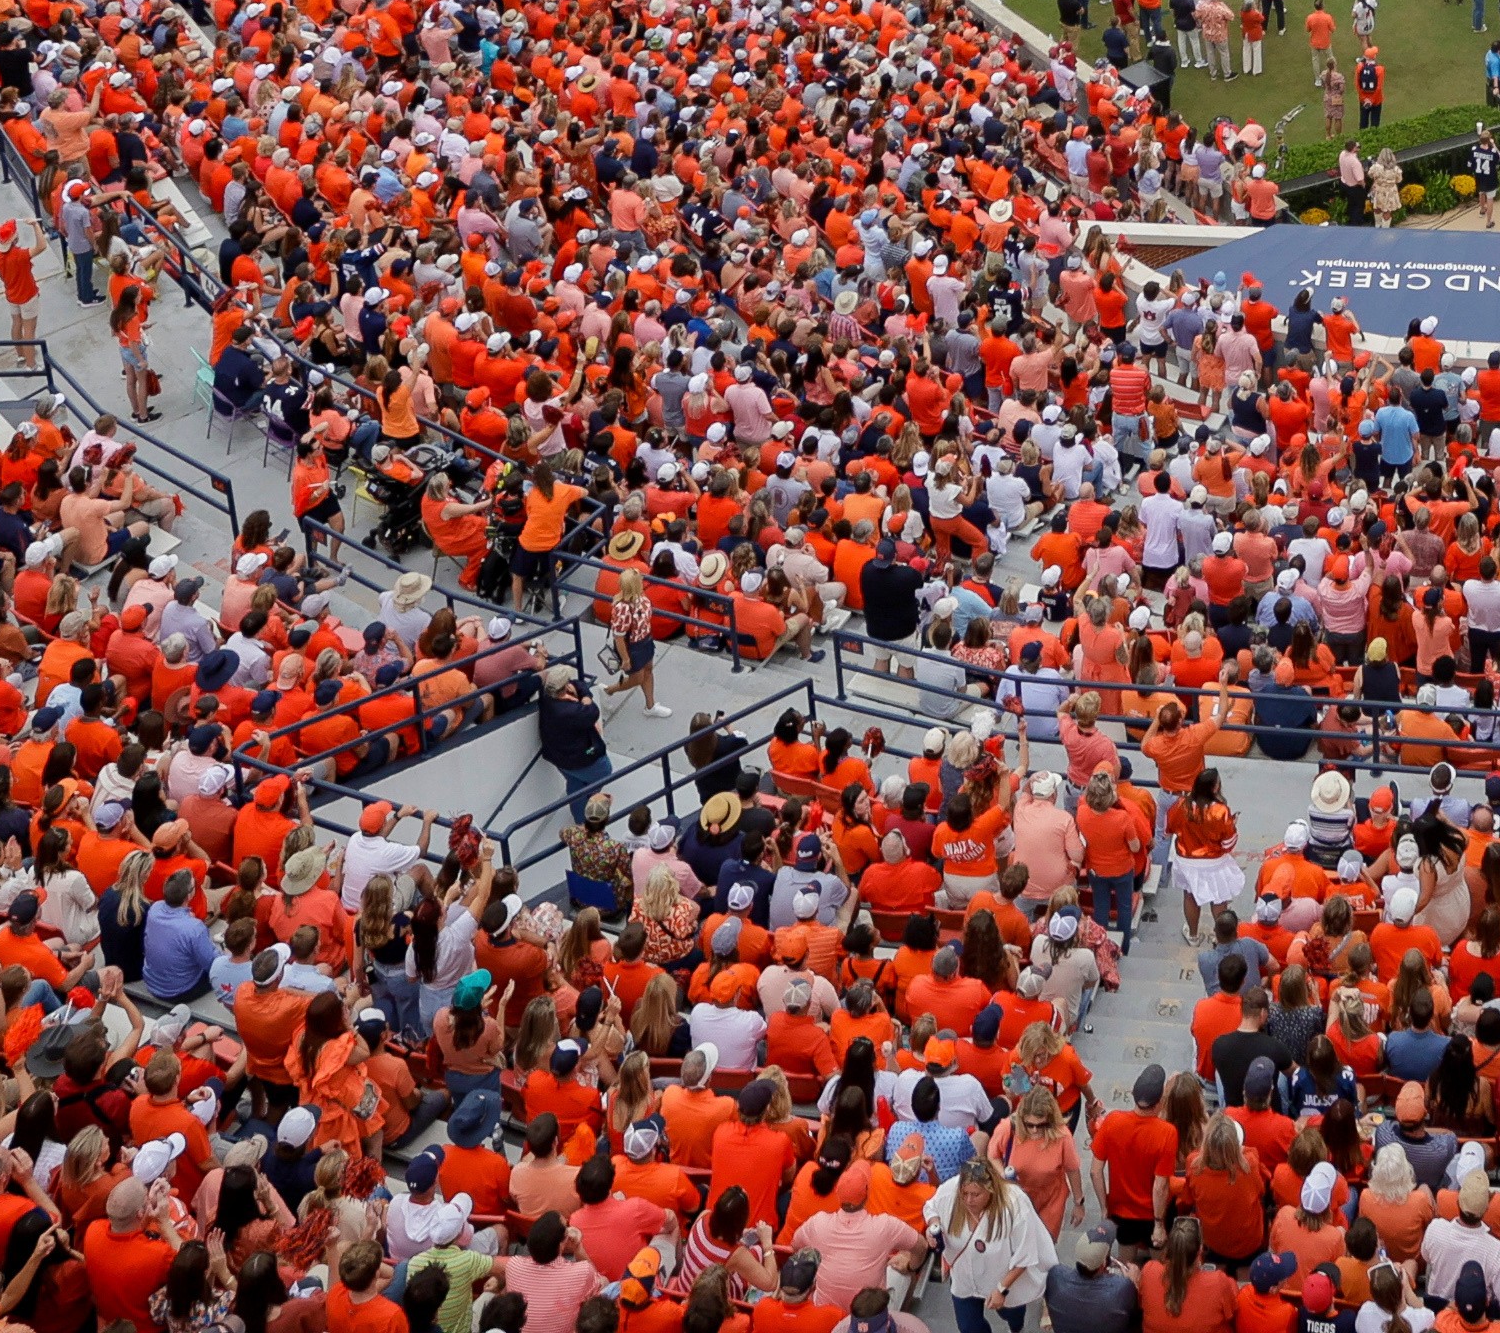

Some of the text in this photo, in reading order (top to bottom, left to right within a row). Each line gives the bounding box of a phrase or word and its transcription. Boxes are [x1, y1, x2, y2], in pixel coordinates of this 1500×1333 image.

[1317, 258, 1391, 272] Wetumpka
[1403, 261, 1487, 274] Montgomery
[1300, 269, 1431, 292] CREEK
[944, 840, 967, 857] WAIT
[1306, 1319, 1335, 1333] TIGERS
